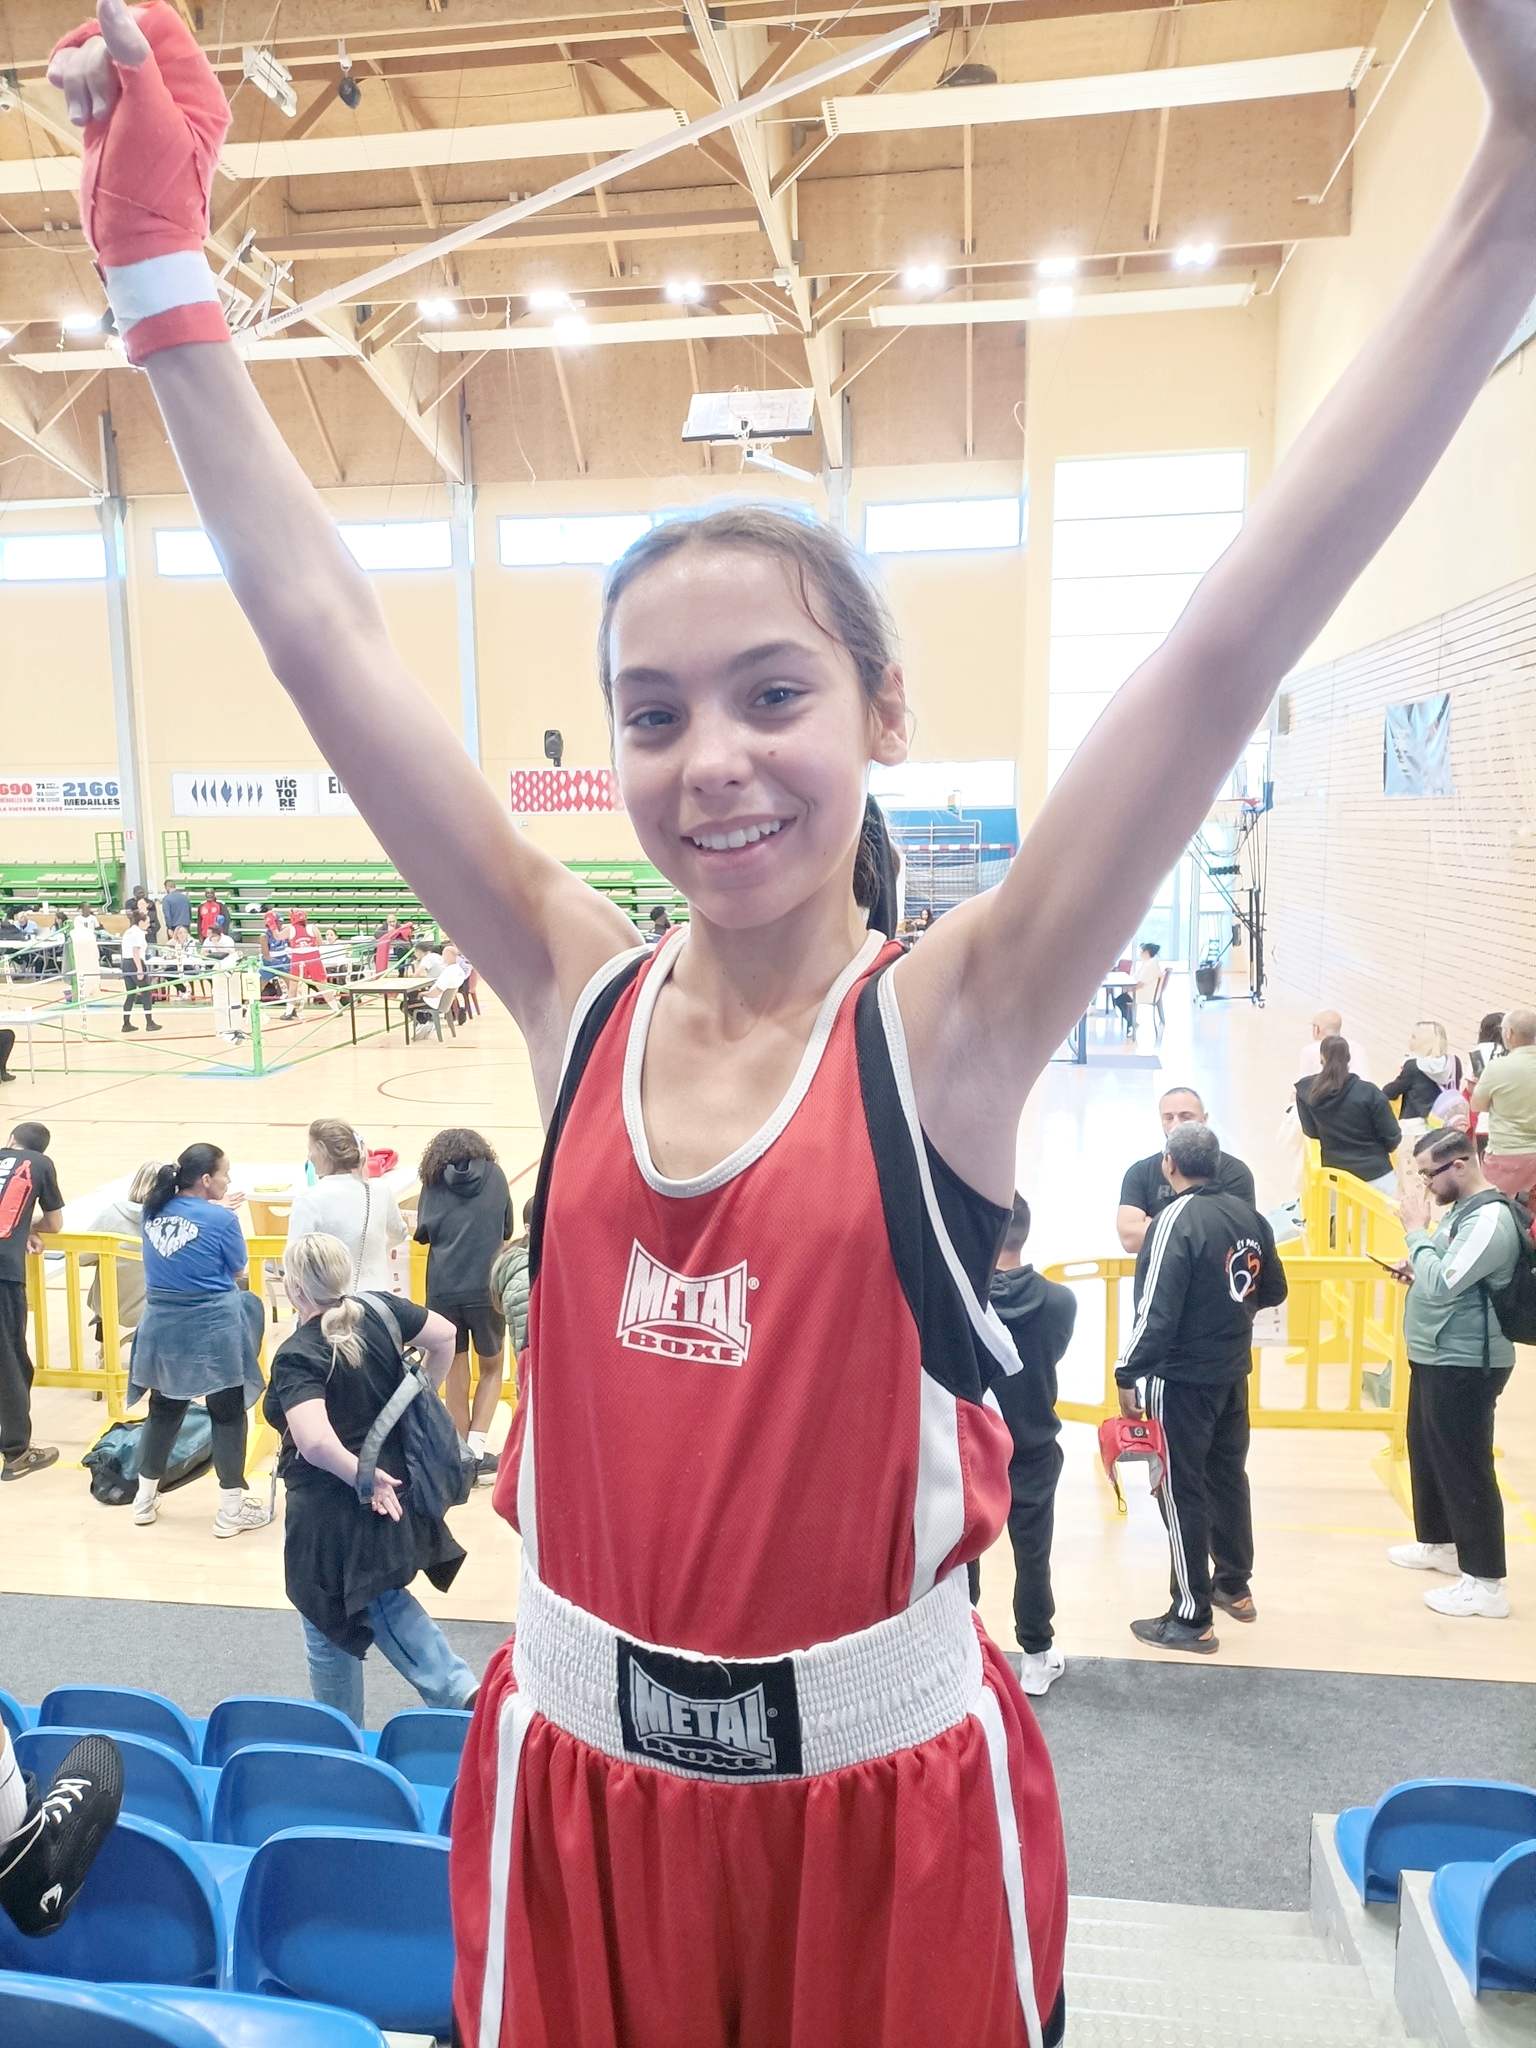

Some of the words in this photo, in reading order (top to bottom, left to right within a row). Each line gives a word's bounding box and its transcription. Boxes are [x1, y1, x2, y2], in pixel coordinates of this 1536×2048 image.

[62, 781, 119, 797] 2166
[279, 798, 296, 808] RE
[245, 978, 257, 992] B
[624, 1250, 747, 1347] METAL
[627, 1330, 742, 1363] BOXE
[634, 1666, 772, 1758] METAL
